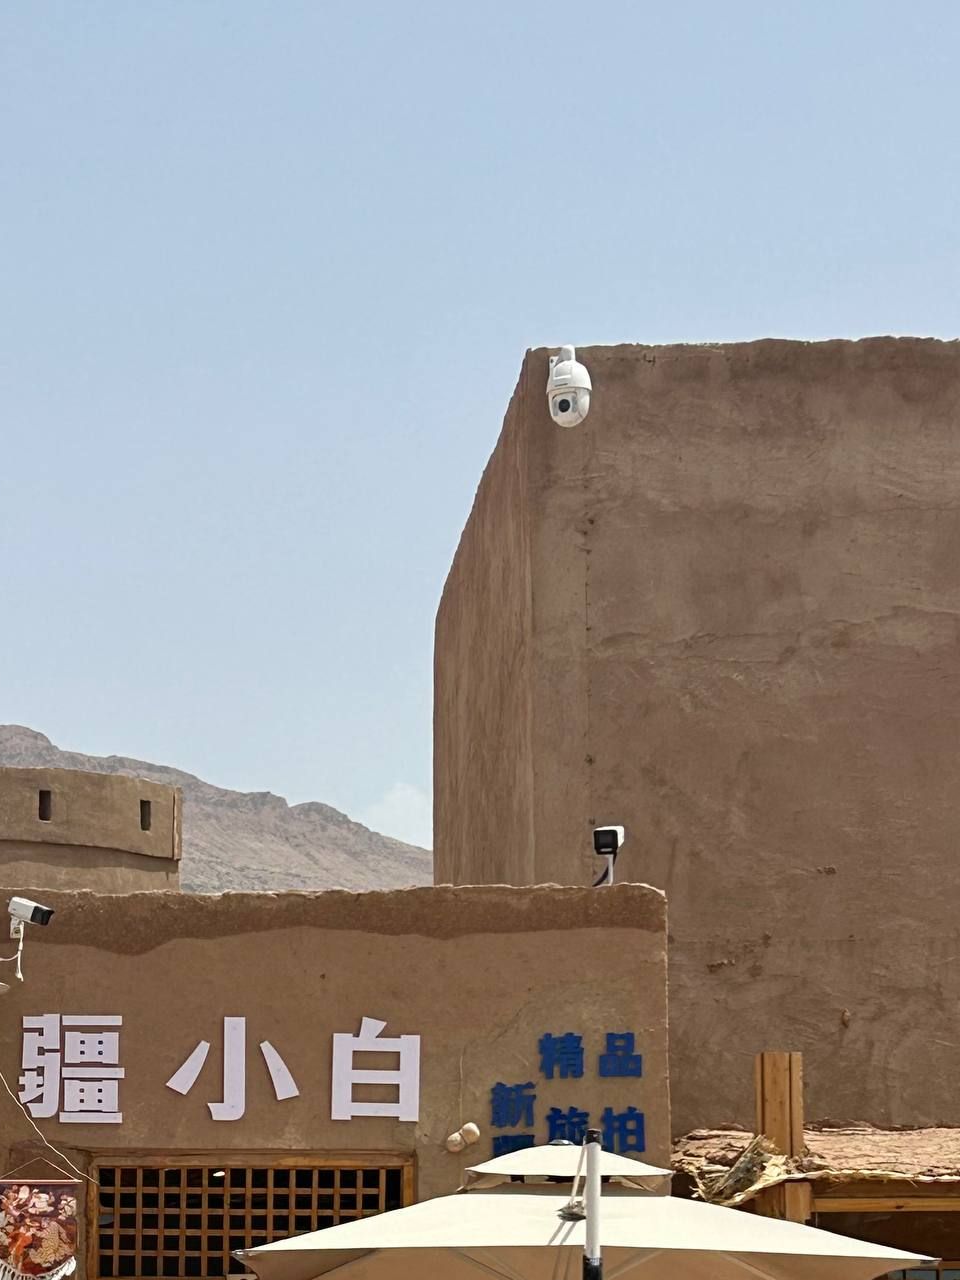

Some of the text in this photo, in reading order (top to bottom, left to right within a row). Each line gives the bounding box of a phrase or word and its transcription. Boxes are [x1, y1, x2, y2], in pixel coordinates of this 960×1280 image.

[18, 1013, 421, 1124] 疆小白
[538, 1032, 642, 1079] 精品
[546, 1106, 646, 1153] 旅拍
